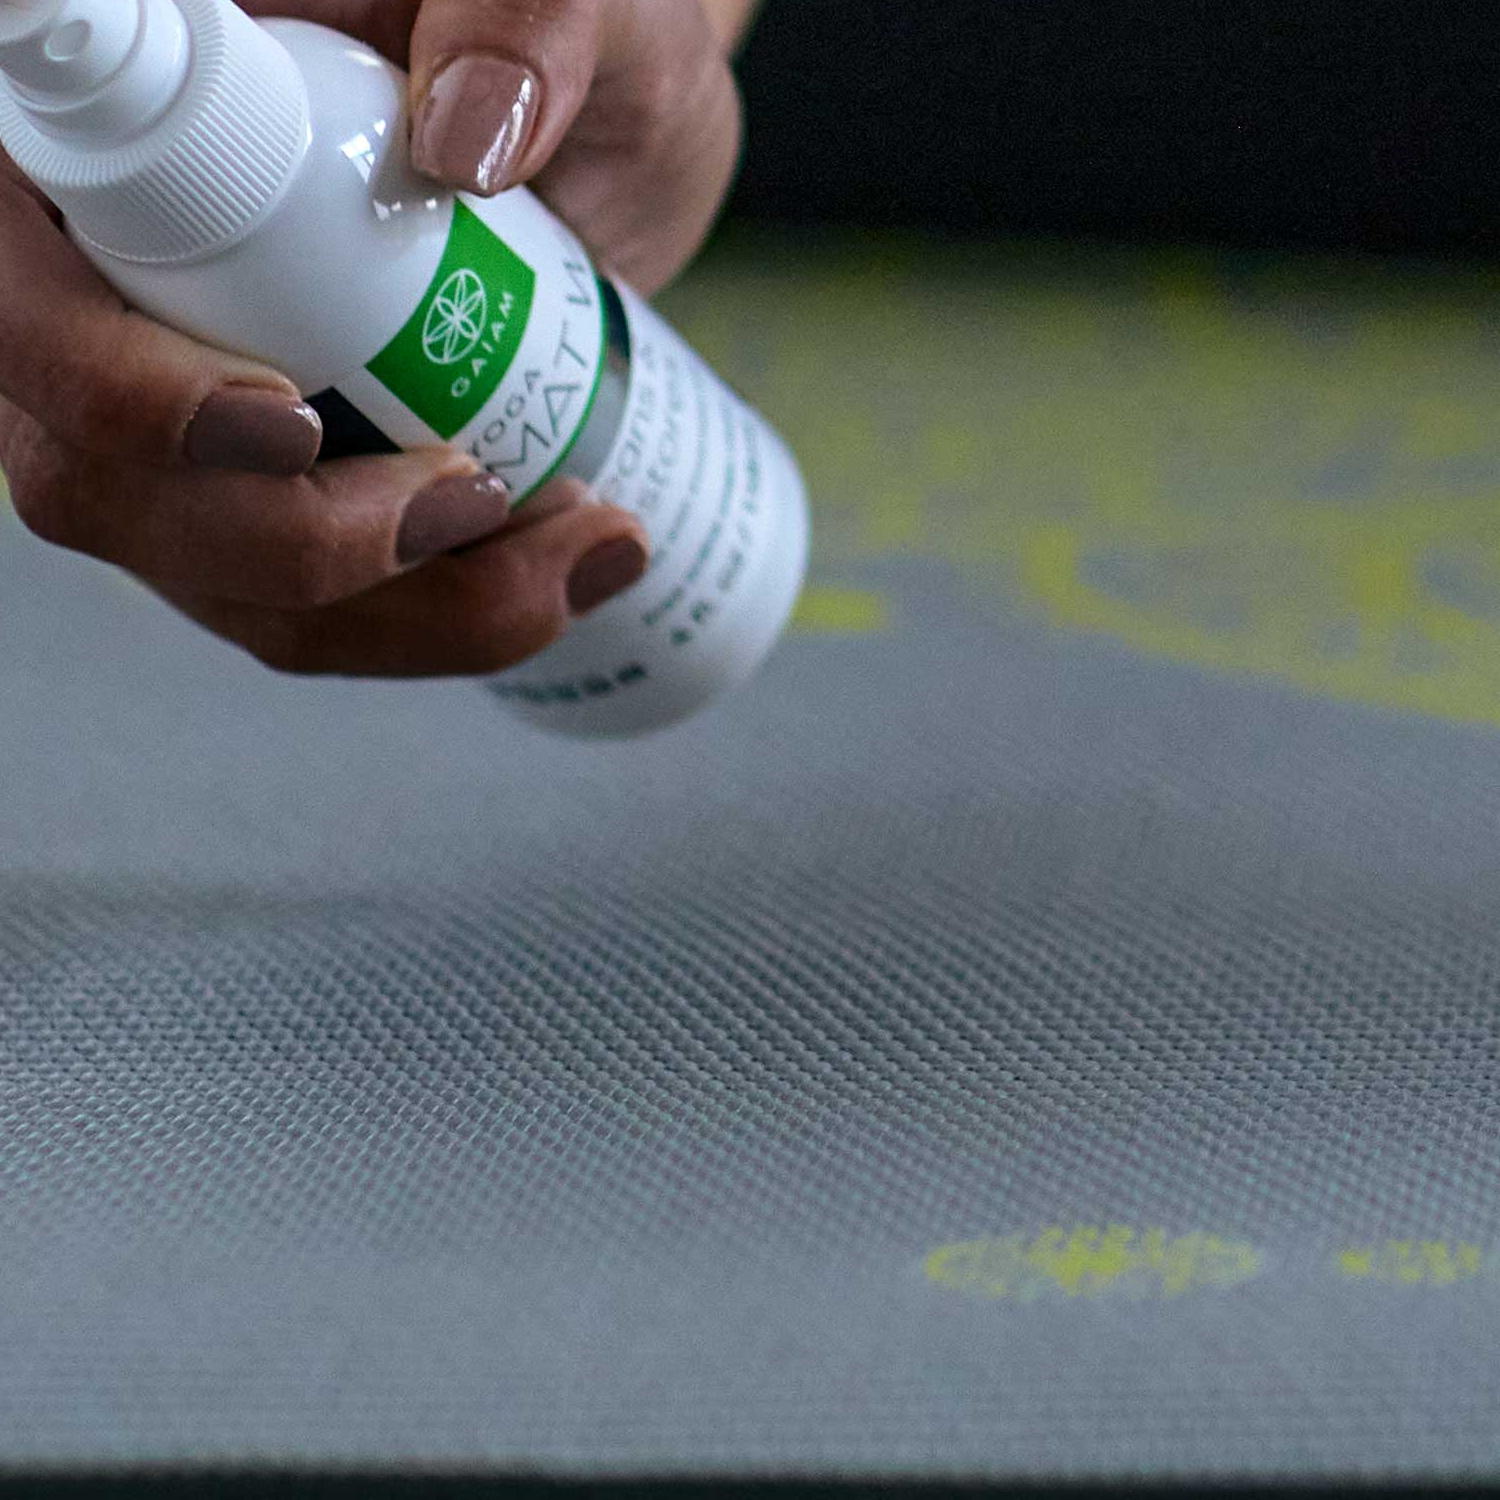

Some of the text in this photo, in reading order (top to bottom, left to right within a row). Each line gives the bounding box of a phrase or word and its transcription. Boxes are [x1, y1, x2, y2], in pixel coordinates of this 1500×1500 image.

[451, 291, 513, 398] GAIAM
[467, 369, 542, 459] YOGA
[484, 318, 588, 490] MAT
